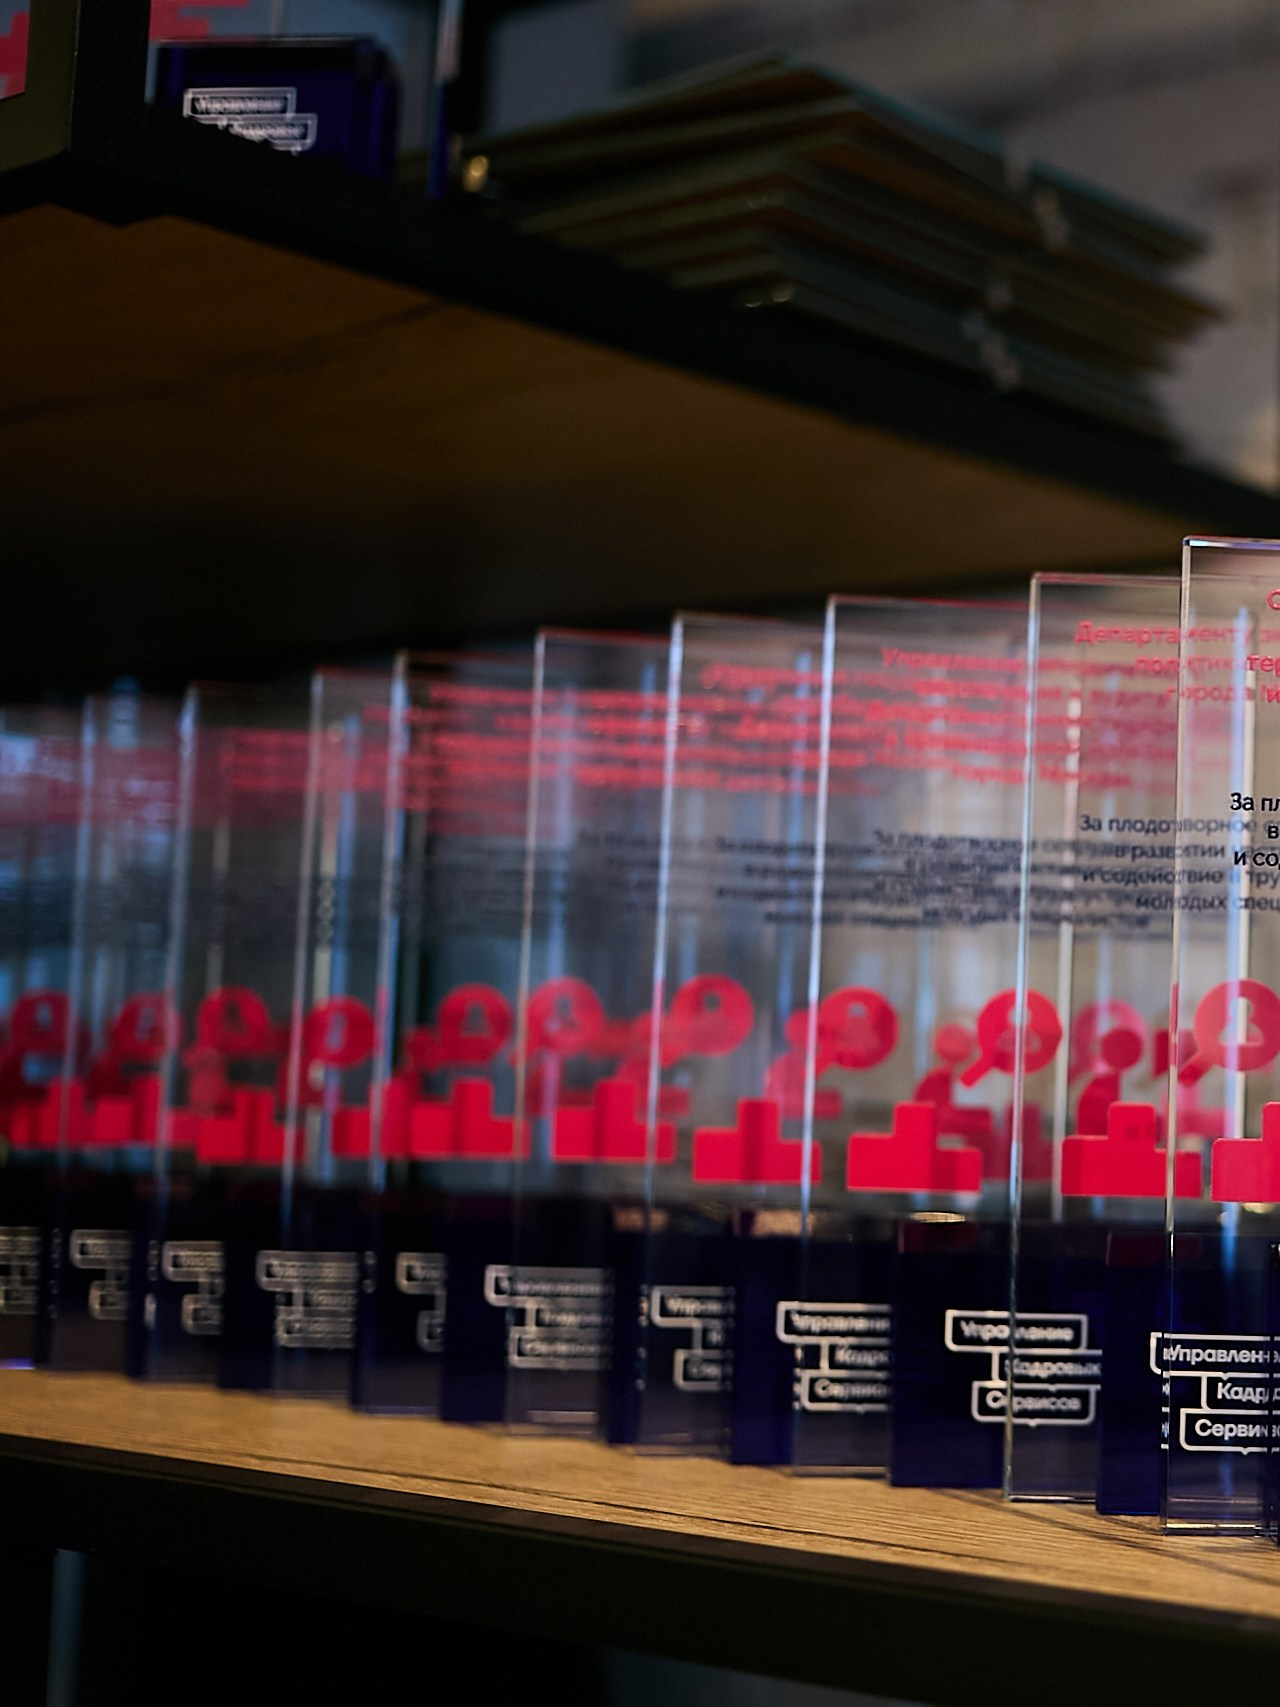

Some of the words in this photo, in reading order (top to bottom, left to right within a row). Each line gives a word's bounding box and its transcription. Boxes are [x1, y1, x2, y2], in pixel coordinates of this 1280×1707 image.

[1230, 792, 1254, 813] За
[1080, 814, 1102, 832] За
[1267, 825, 1279, 841] в
[1234, 851, 1247, 866] и
